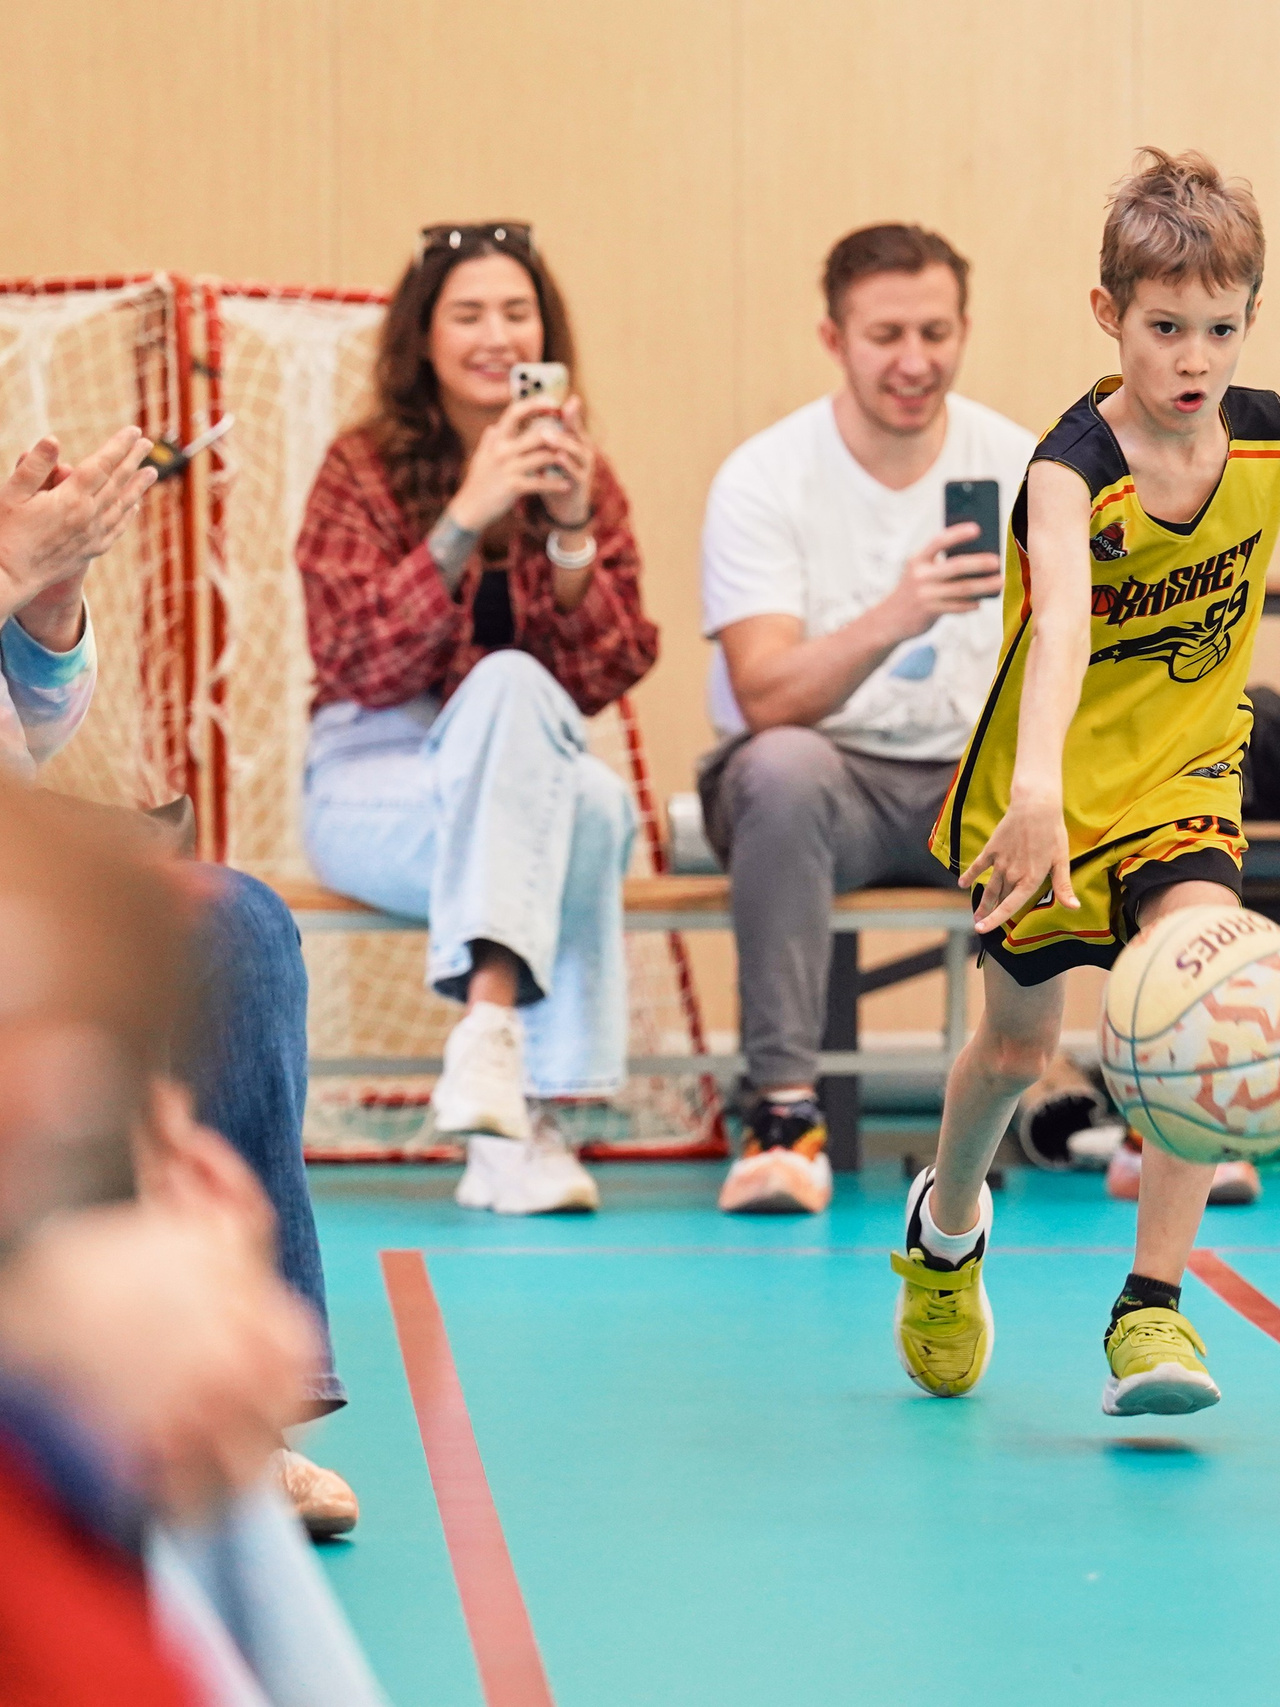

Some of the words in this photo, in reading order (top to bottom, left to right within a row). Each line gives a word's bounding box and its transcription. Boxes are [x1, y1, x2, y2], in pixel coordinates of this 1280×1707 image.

[1092, 535, 1125, 558] ASKET
[1106, 529, 1263, 629] BASKET
[1176, 913, 1280, 979] ORRES
